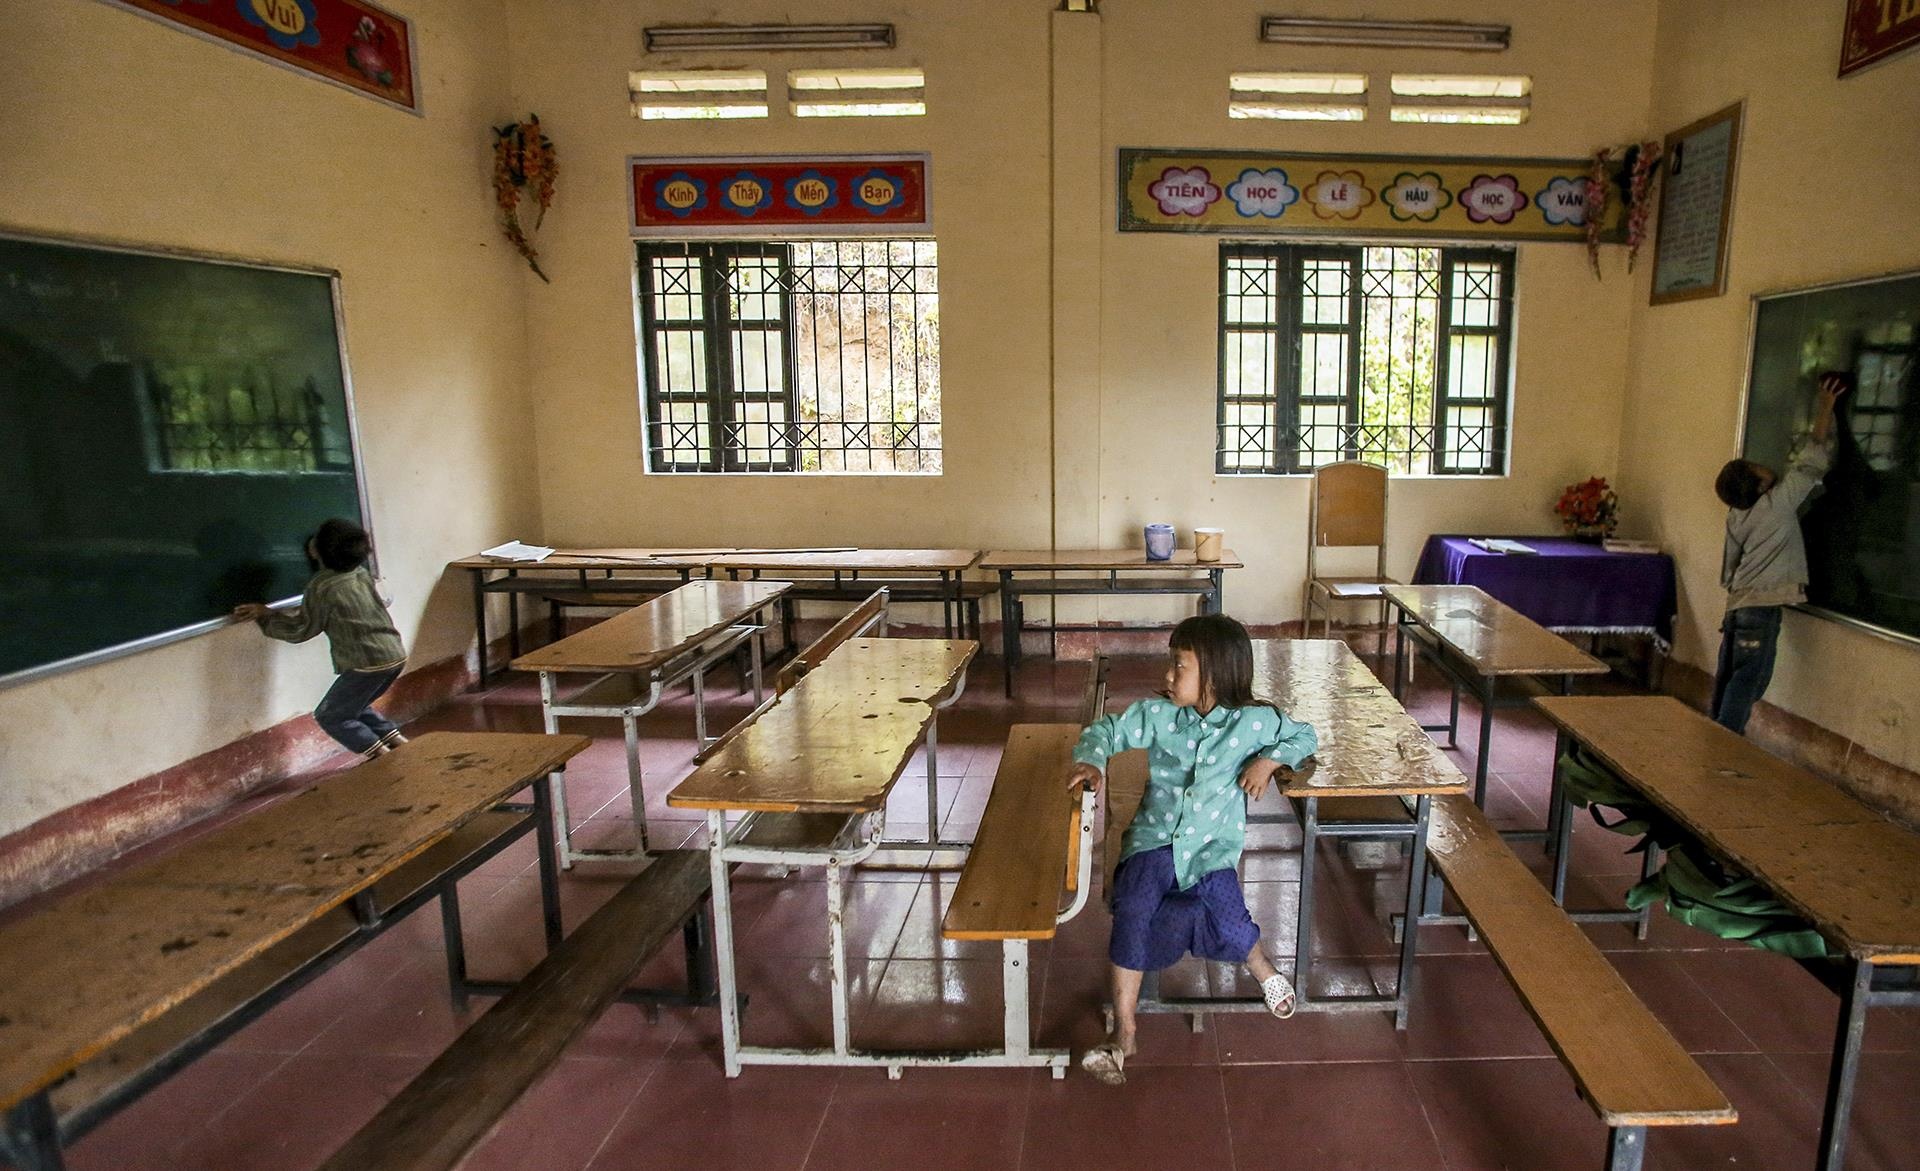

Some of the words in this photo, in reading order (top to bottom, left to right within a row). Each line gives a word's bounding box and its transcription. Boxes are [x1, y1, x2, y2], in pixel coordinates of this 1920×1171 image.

[264, 0, 297, 30] Vui
[800, 182, 825, 201] Mến
[865, 185, 892, 203] Bạn
[1165, 182, 1205, 198] TIÊN
[1247, 187, 1277, 202] HỌC
[1405, 186, 1429, 205] HẬU
[1482, 193, 1504, 209] HỌC
